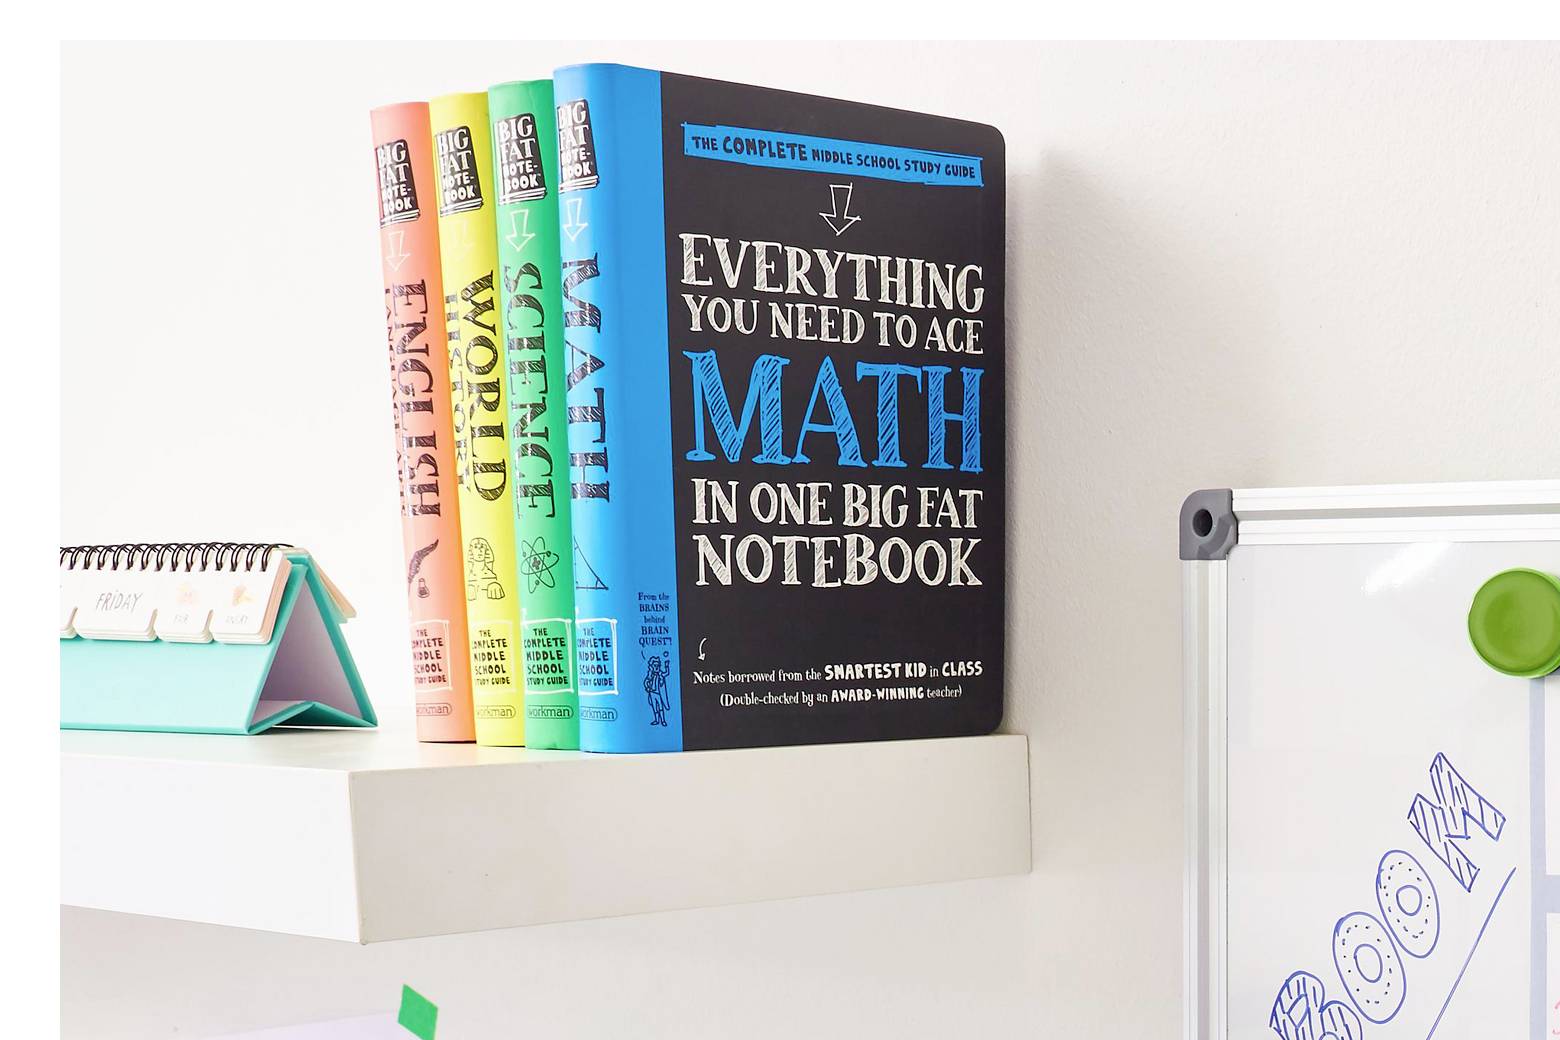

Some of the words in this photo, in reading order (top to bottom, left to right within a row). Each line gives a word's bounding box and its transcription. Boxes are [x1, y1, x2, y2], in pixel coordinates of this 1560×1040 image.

[498, 116, 533, 142] BIG
[500, 138, 536, 164] FAT
[692, 136, 718, 151] THE
[722, 136, 808, 161] COMPLETE
[811, 148, 854, 166] MIDDLE
[856, 154, 901, 171] SCHOOL
[904, 159, 941, 175] STUDY
[944, 163, 976, 179] GUIDE
[678, 232, 985, 313] EVERYTHING
[681, 293, 760, 335] YOU
[768, 301, 866, 344] NEED
[872, 311, 918, 348] TO
[924, 316, 984, 355] ACE
[460, 270, 507, 501] WORLD
[503, 262, 556, 519] SCIENCE
[562, 252, 610, 503] MATH
[392, 279, 441, 517] ENGLISH
[682, 349, 985, 474] MATH
[690, 478, 740, 524] IN
[749, 481, 833, 525] ONE
[842, 482, 910, 528] BIG
[916, 486, 984, 529] FAT
[692, 533, 983, 588] NOTEBOOK
[640, 603, 669, 611] BRAINS
[411, 637, 444, 648] OMPLETE
[523, 637, 566, 648] COMPLETE
[533, 628, 548, 636] THE
[641, 626, 669, 635] BRAIN
[526, 650, 564, 661] MIDDLE
[528, 663, 564, 674] SCHOOL
[475, 664, 506, 675] SCHOOL
[546, 676, 569, 685] GUIDE
[693, 671, 726, 684] Notes
[728, 669, 776, 683] borrowed
[778, 669, 803, 682] from
[805, 669, 822, 681] the
[824, 663, 901, 681] SMARTEST
[904, 662, 927, 679] KID
[929, 664, 940, 678] in
[941, 660, 983, 677] CLASS
[801, 691, 814, 707] by
[816, 693, 828, 702] an
[830, 687, 925, 702] AWARD-WINNING
[926, 685, 963, 699] teacher)
